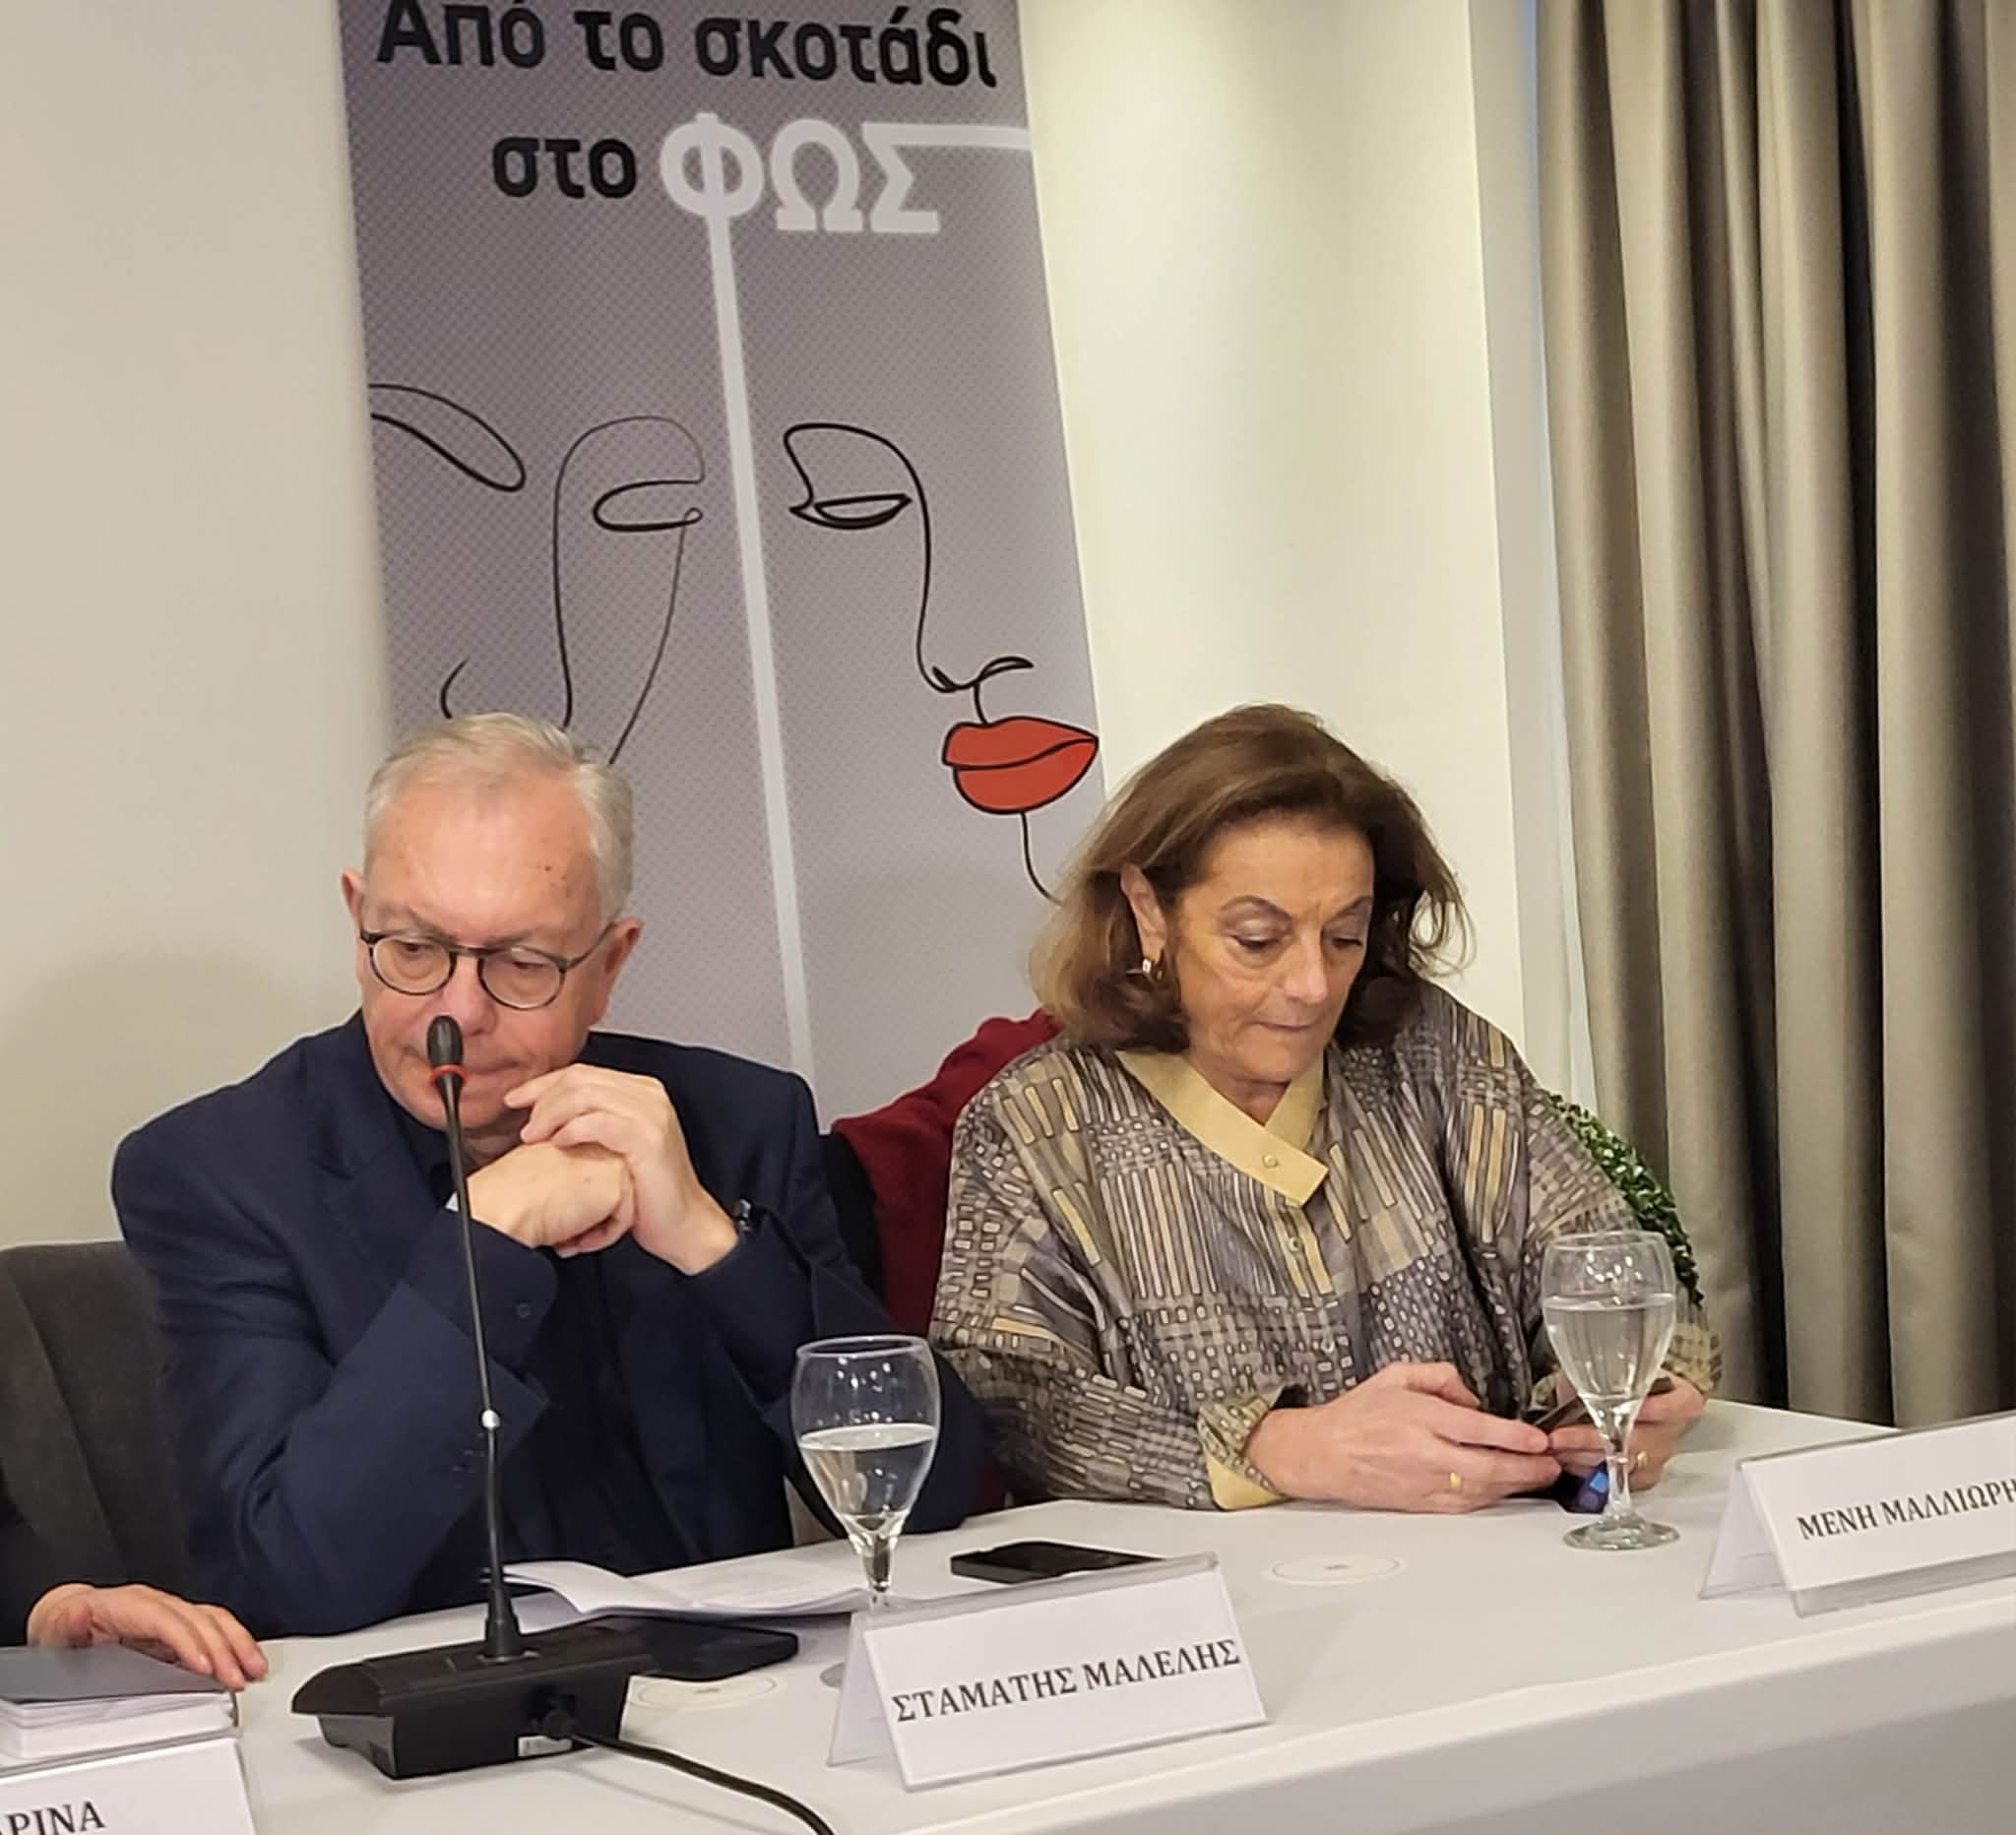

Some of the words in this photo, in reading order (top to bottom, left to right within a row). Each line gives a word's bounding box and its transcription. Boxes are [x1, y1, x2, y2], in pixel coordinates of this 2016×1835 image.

[374, 0, 546, 70] Από
[573, 9, 665, 74] το
[693, 5, 997, 89] σκοτάδι
[491, 136, 639, 200] στο
[659, 112, 945, 235] ΦΩΣ
[1796, 1503, 1879, 1540] ΜΕΝΗ
[1879, 1478, 2016, 1527] ΜΑΛΛΙΩΡΗ
[891, 1667, 1079, 1723] ΣΤΑΜΑΤΗΣ
[1082, 1638, 1241, 1692] ΜΑΛΕΛΗΣ
[0, 1800, 106, 1835] ΡΙΝΑ
